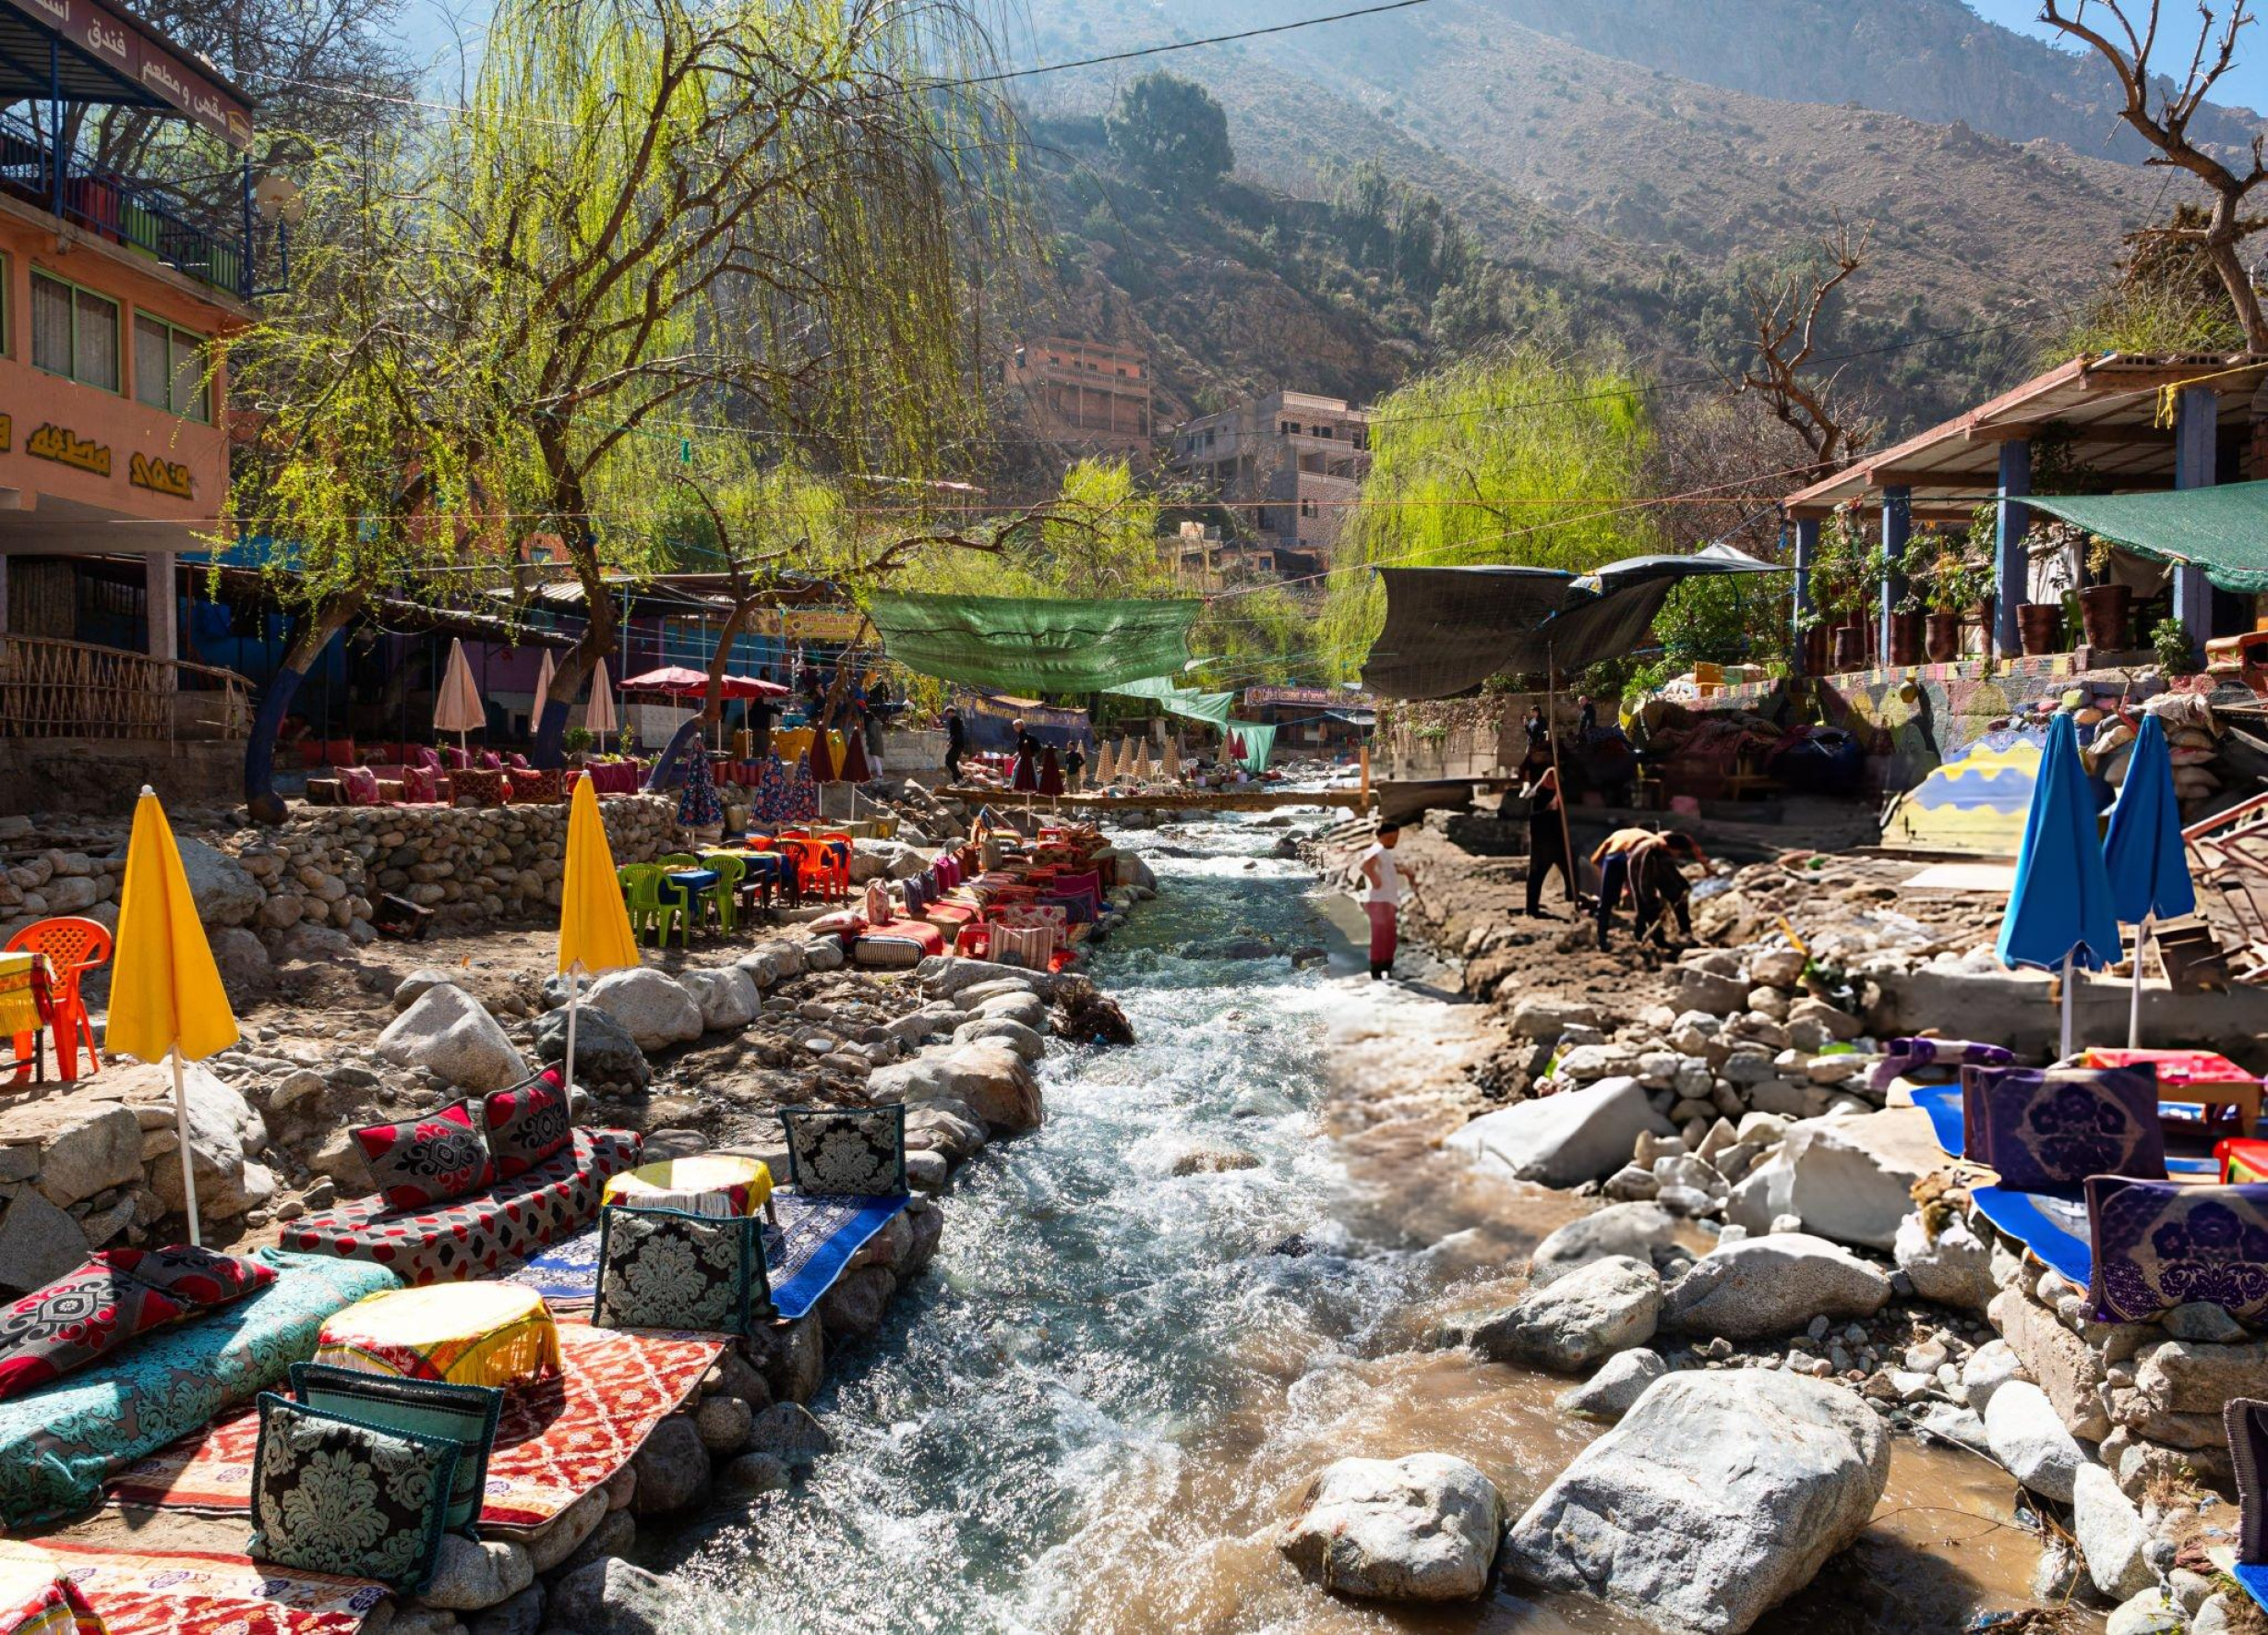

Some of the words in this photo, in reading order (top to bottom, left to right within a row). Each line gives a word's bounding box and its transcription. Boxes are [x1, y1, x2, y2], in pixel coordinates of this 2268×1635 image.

[88, 18, 126, 57] فندق
[142, 61, 180, 95] مطعم
[182, 85, 189, 106] و
